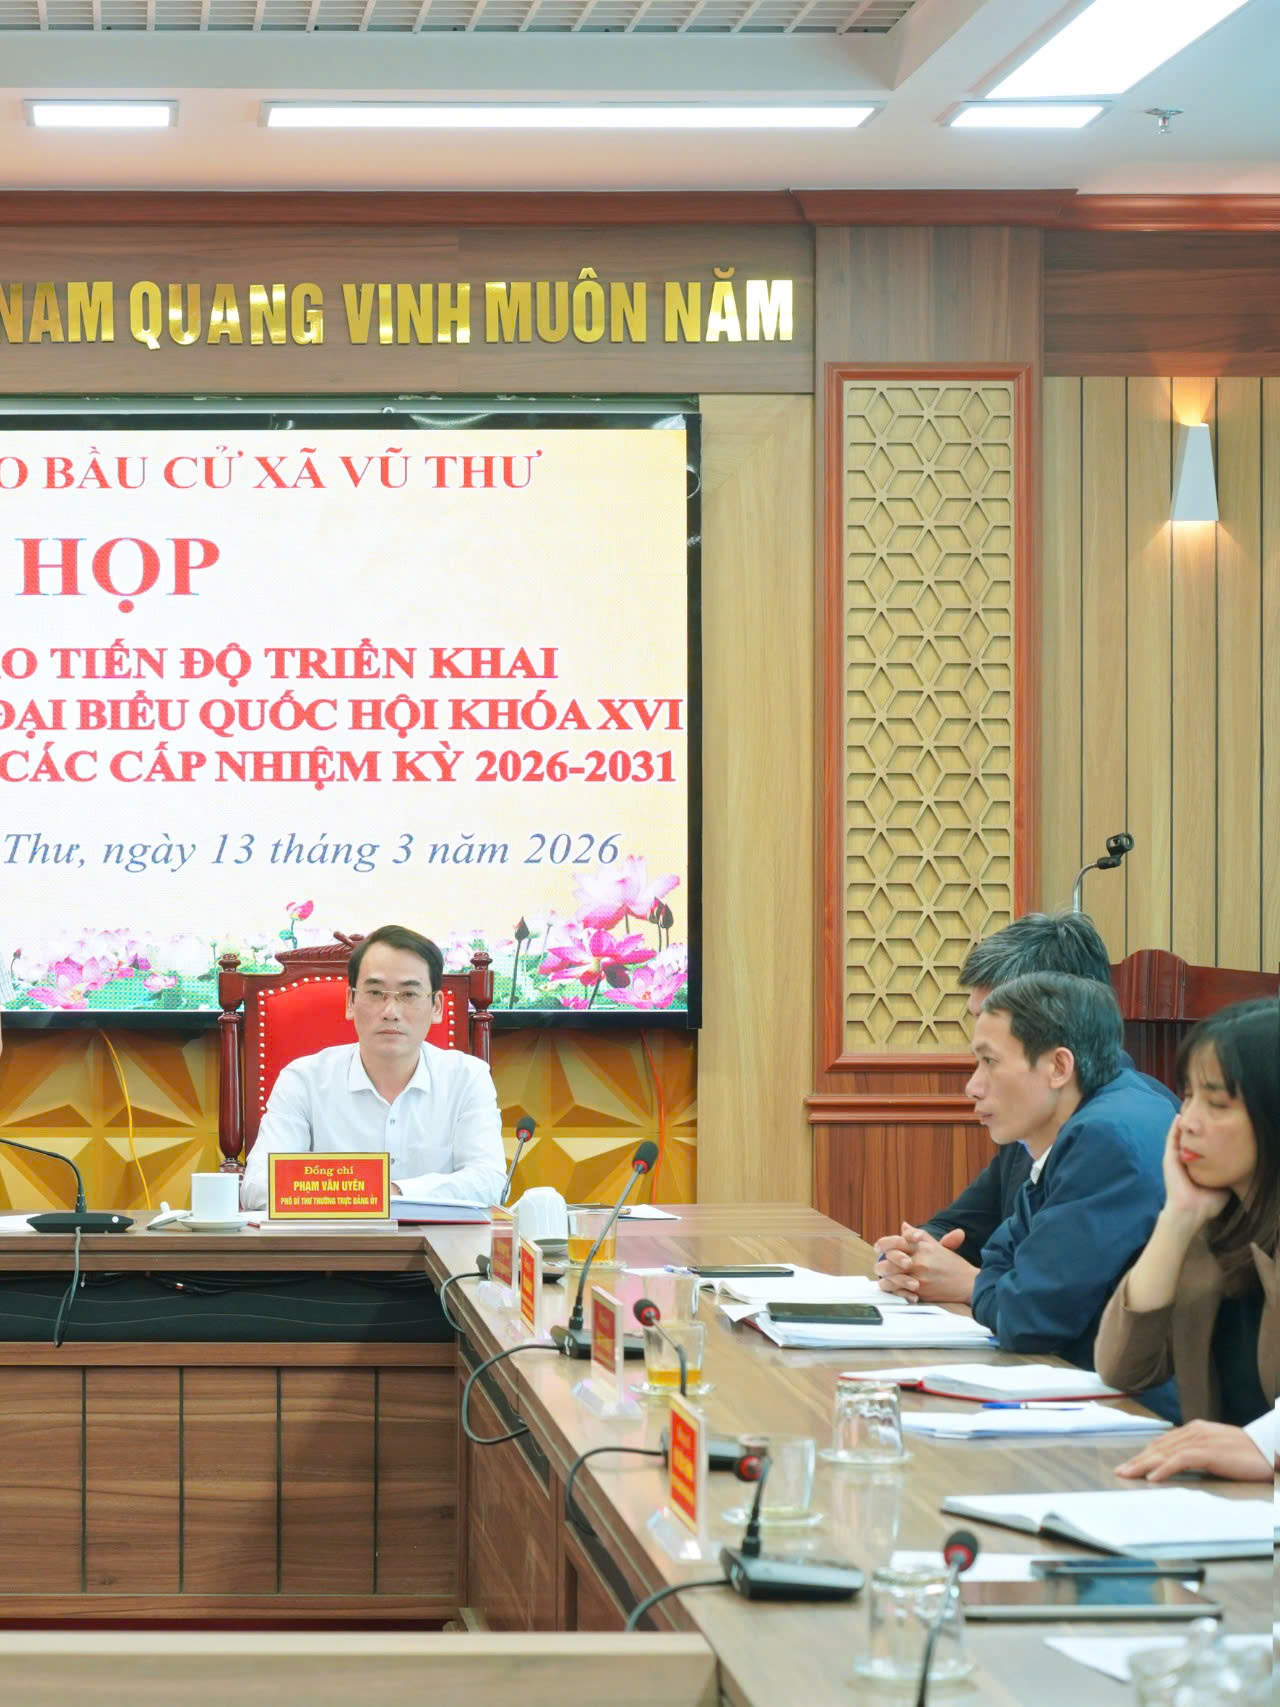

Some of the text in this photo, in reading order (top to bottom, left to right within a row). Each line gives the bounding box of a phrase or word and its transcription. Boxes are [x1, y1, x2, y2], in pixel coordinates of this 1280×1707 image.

[130, 281, 324, 351] QUANG
[342, 281, 471, 344] VINH
[485, 267, 646, 344] MUÔN
[665, 267, 793, 344] NĂM
[41, 445, 150, 490] BẦU
[163, 445, 244, 490] CỬ
[253, 447, 326, 489] XÃ
[340, 447, 413, 489] VŨ
[425, 449, 543, 489] THƯ
[15, 537, 220, 614] HỌP
[50, 637, 168, 680] TIẾN
[180, 642, 252, 688] ĐỘ
[264, 637, 417, 680] TRIỂN
[430, 648, 558, 679] KHAI
[76, 689, 189, 731] BIỂU
[199, 689, 337, 738] QUỐC
[348, 693, 439, 739] HỘI
[447, 689, 591, 731] KHÓA
[597, 698, 684, 731] XVI
[109, 741, 207, 783] CẤP
[215, 745, 381, 791] NHIỆM
[393, 740, 465, 783] KỲ
[475, 749, 676, 783] 2026-2031
[4, 833, 86, 869] Thư,
[103, 833, 197, 874] ngày
[211, 833, 256, 865] 13
[270, 832, 380, 873] tháng
[392, 833, 415, 865] 3
[428, 832, 509, 865] năm
[524, 833, 623, 865] 2026
[293, 1179, 365, 1194] PHẠM VĂN UYÊN
[304, 1165, 354, 1177] Đồng chí
